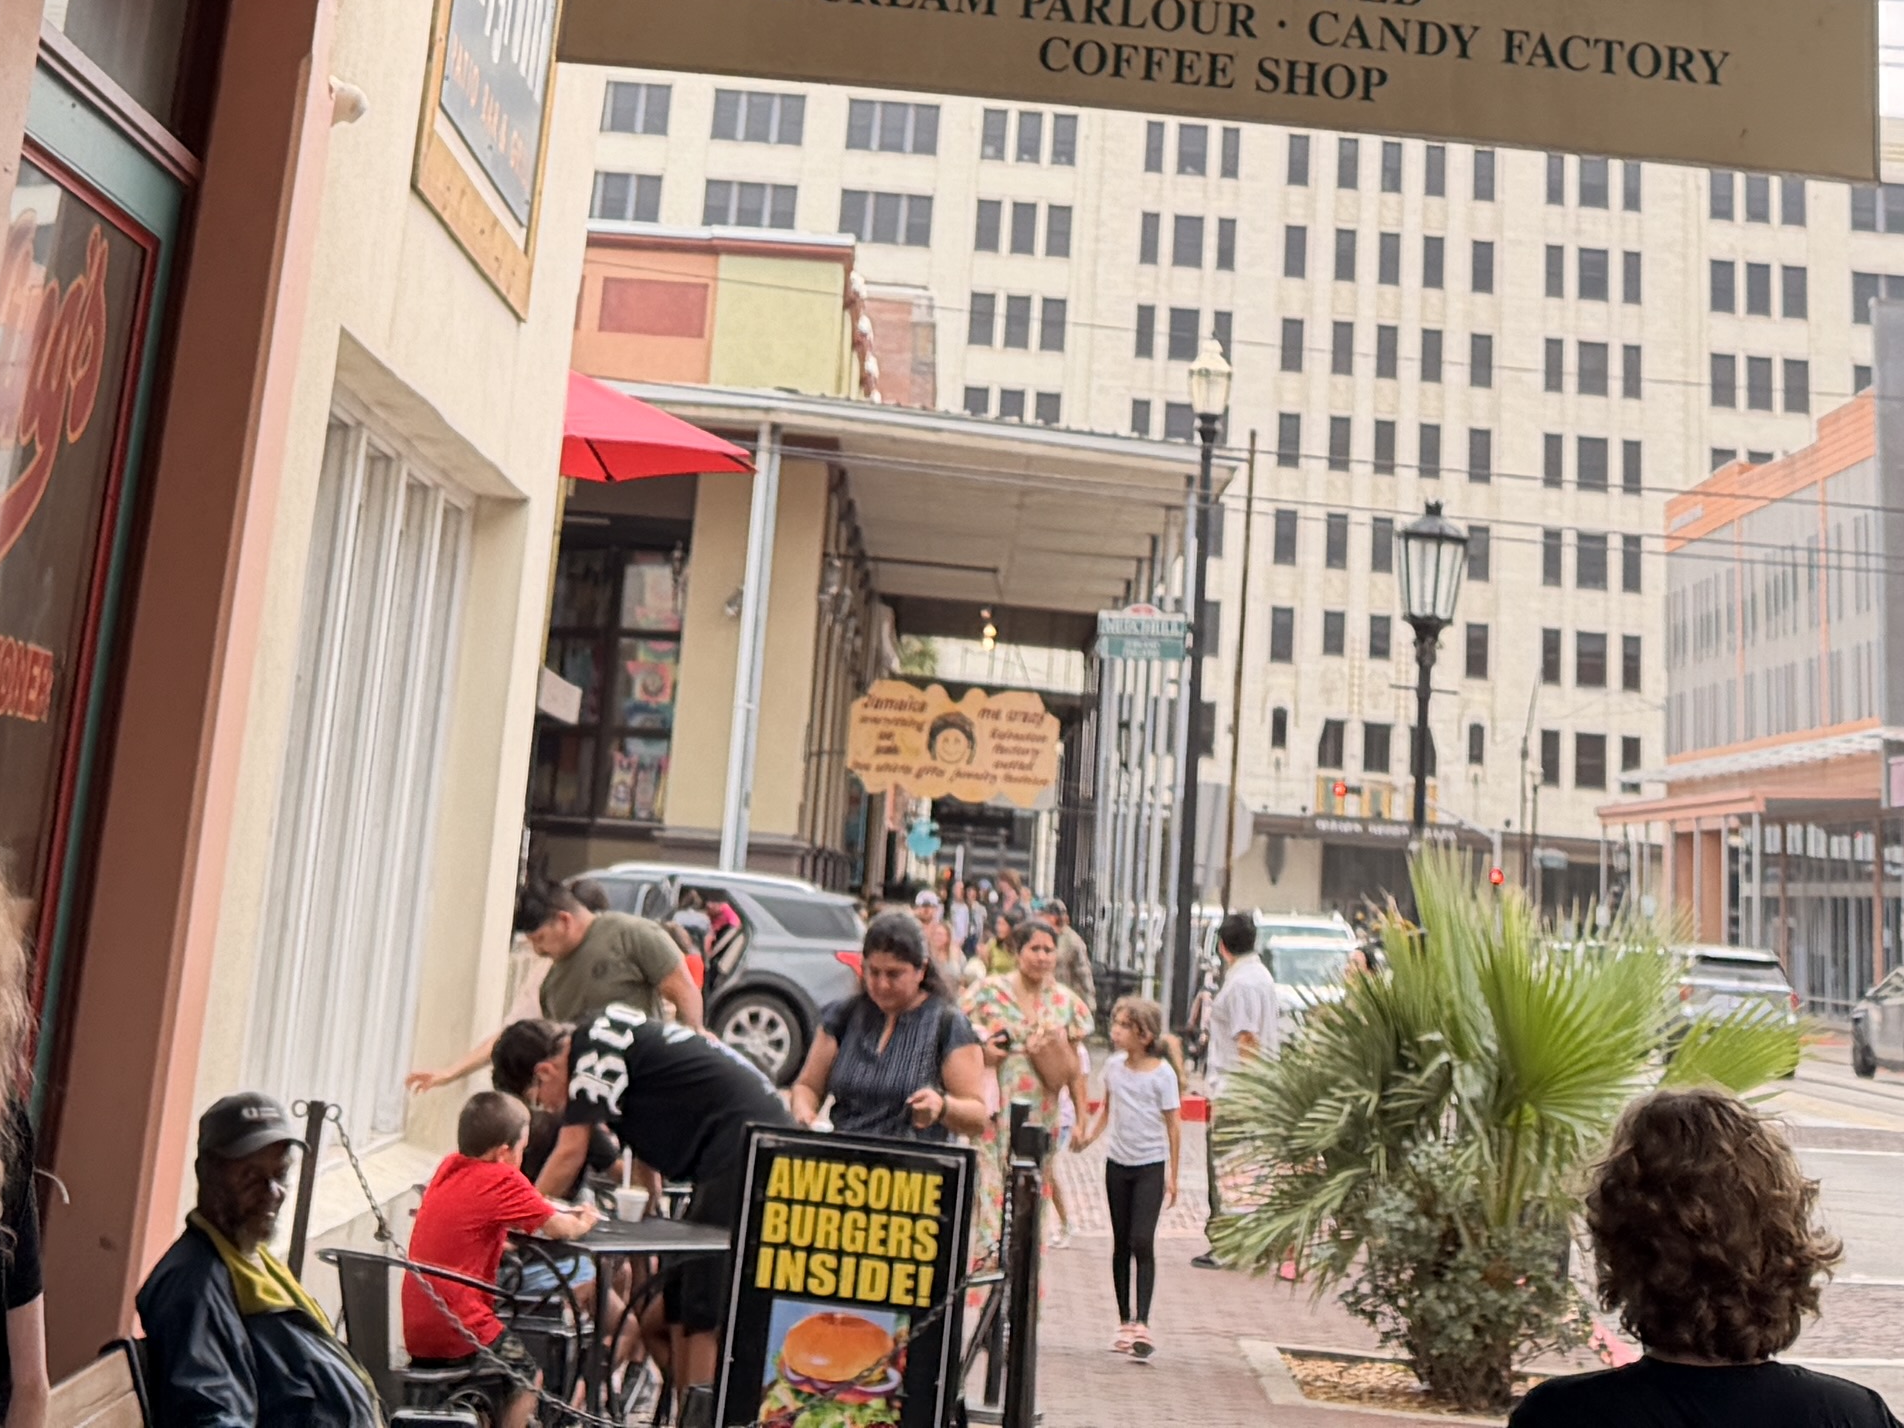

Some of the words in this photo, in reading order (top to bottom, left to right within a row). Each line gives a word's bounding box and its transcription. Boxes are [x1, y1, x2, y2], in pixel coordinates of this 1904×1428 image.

[1038, 35, 1236, 90] COFFEE
[1256, 56, 1389, 103] SHOP
[1307, 10, 1482, 62] CANDY
[1500, 28, 1732, 88] FACTORY
[765, 1155, 944, 1217] AWESOME
[760, 1201, 940, 1262] BURGERS
[754, 1246, 935, 1308] INSIDE!
